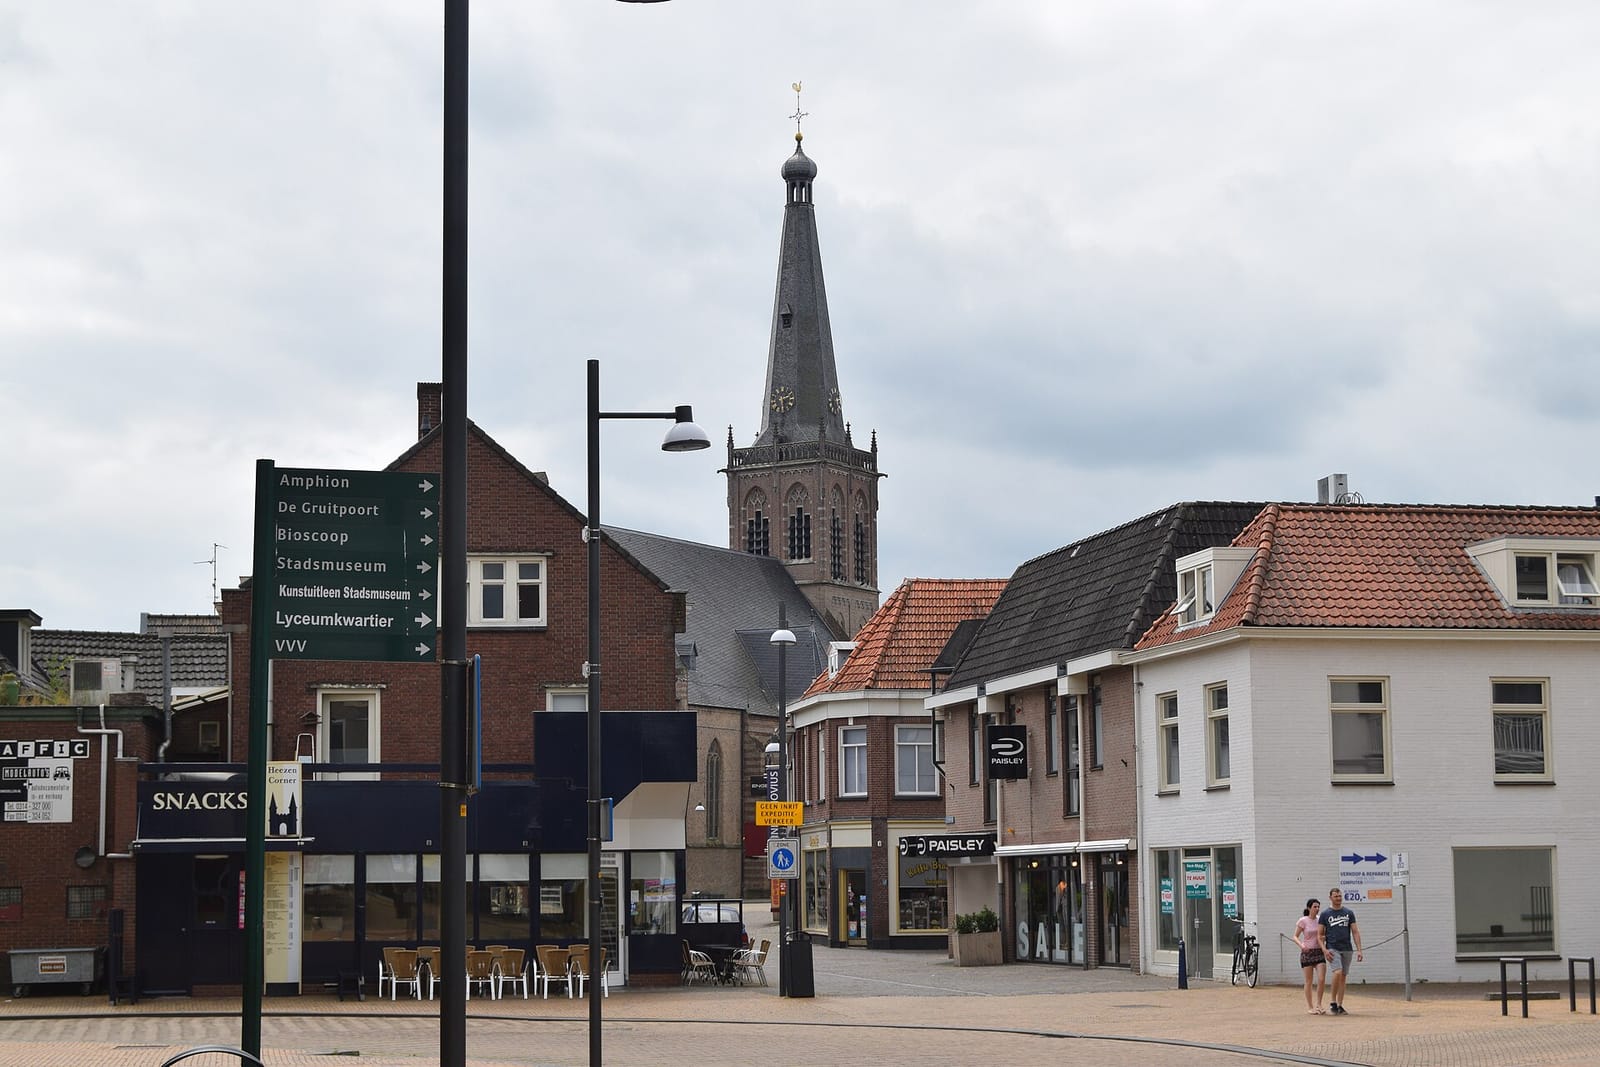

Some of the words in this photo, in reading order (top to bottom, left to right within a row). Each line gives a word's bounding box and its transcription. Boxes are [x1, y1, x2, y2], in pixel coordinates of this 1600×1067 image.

[279, 473, 350, 490] Amphion
[278, 501, 297, 513] De
[301, 502, 379, 518] Gruitpoort
[277, 528, 349, 545] Bioscoop
[277, 556, 387, 573] Stadsmuseum
[279, 584, 341, 599] Kunstuitleen
[343, 586, 411, 601] Stadsmuseum
[275, 611, 394, 628] Lyceumkwartier
[275, 639, 307, 653] VVV
[2, 743, 85, 756] AFFIC
[991, 757, 1024, 765] PAISLEY
[268, 766, 297, 774] Heezen
[268, 776, 297, 784] Corner
[153, 792, 248, 810] SNACKS
[929, 839, 985, 851] PAISLEY
[1018, 920, 1085, 961] SALE
